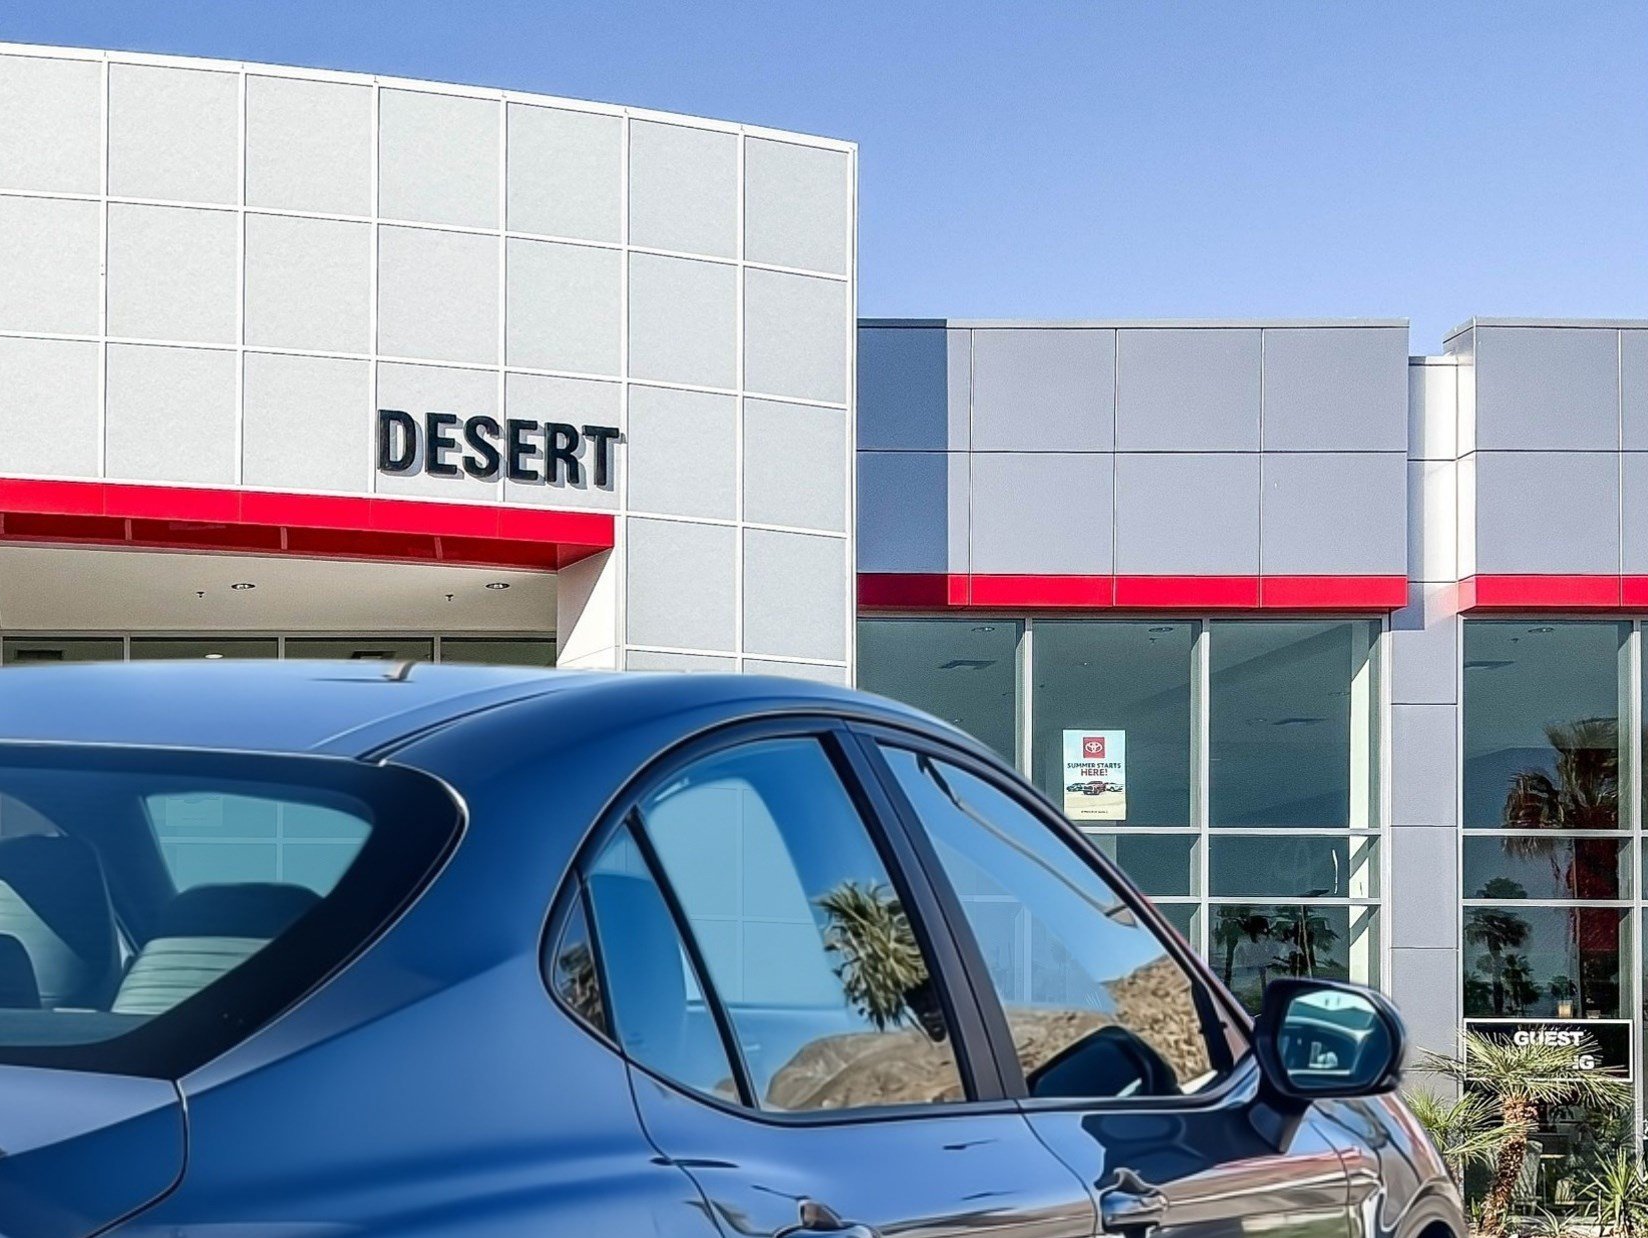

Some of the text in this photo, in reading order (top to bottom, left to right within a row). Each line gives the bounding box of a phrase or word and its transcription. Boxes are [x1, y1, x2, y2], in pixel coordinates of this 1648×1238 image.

[377, 408, 621, 487] DESERT
[1080, 768, 1108, 776] HERE!
[1513, 1030, 1585, 1047] GUEST
